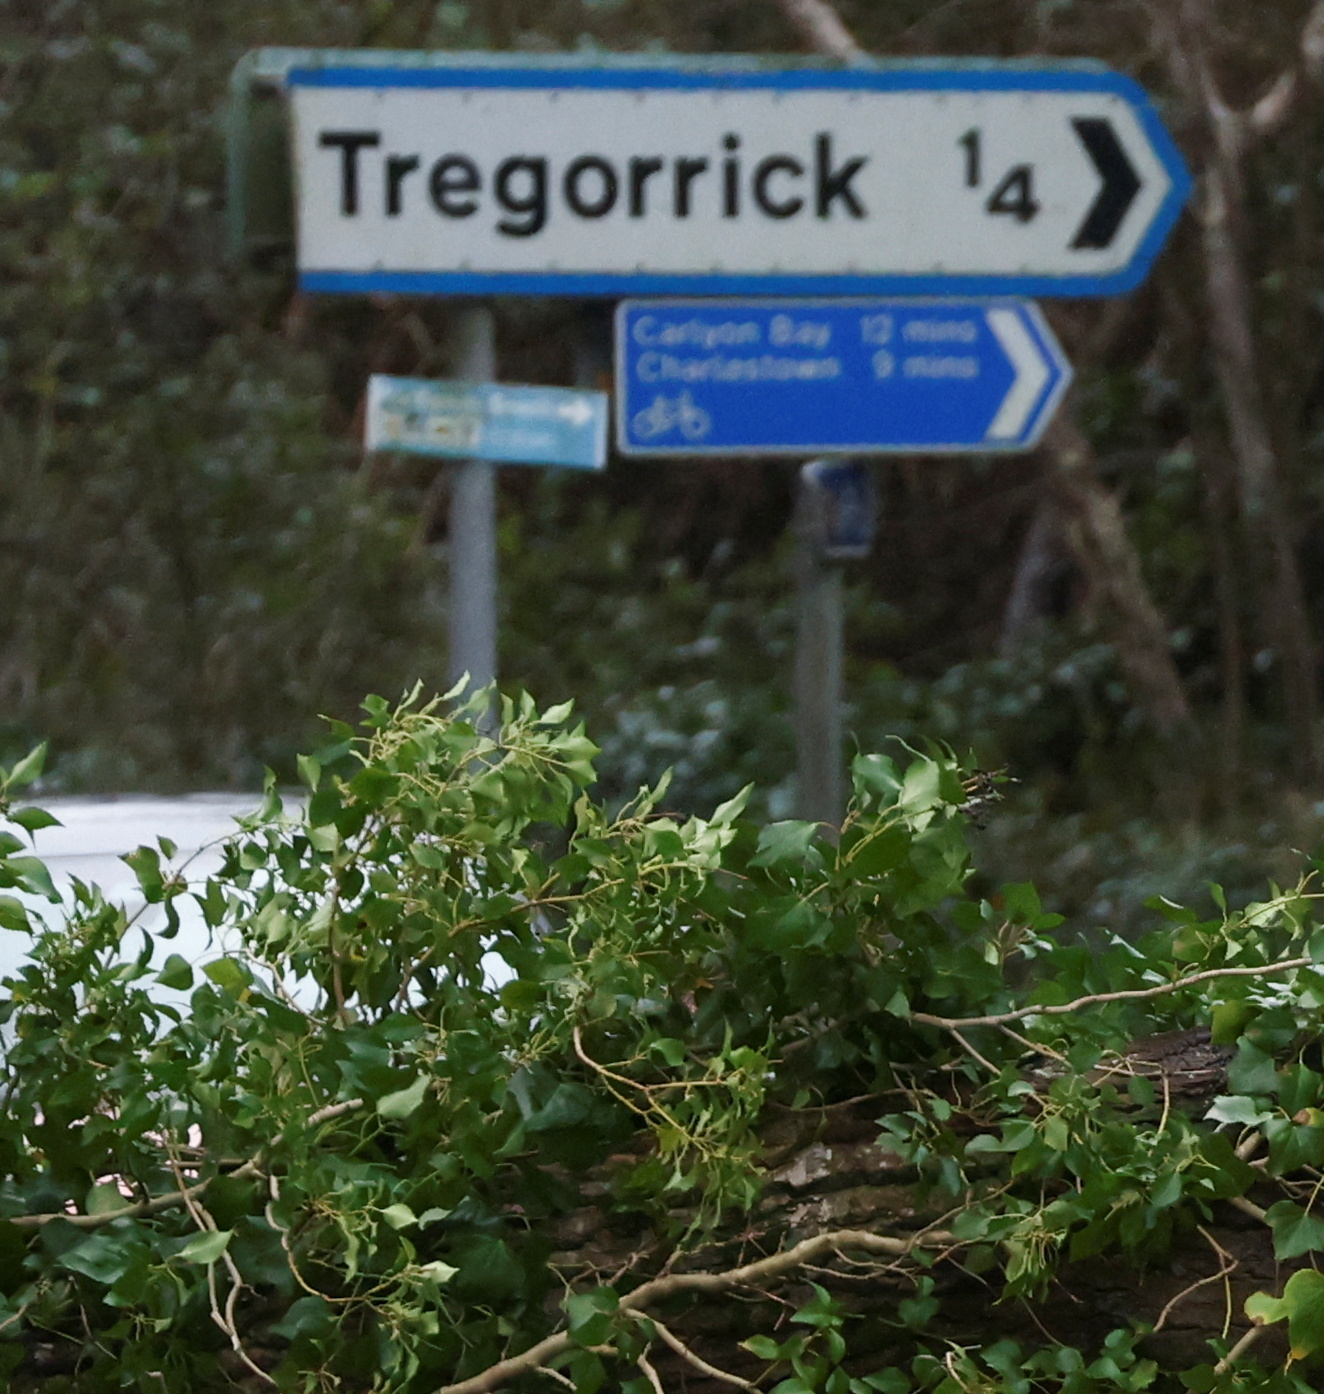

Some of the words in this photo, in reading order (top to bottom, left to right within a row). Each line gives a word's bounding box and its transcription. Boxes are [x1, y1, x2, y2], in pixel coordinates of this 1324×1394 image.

[319, 131, 868, 238] Tregorrick
[769, 314, 831, 349] Bay
[903, 319, 976, 344] mins
[637, 350, 840, 381] Charlestown
[903, 355, 978, 379] mins
